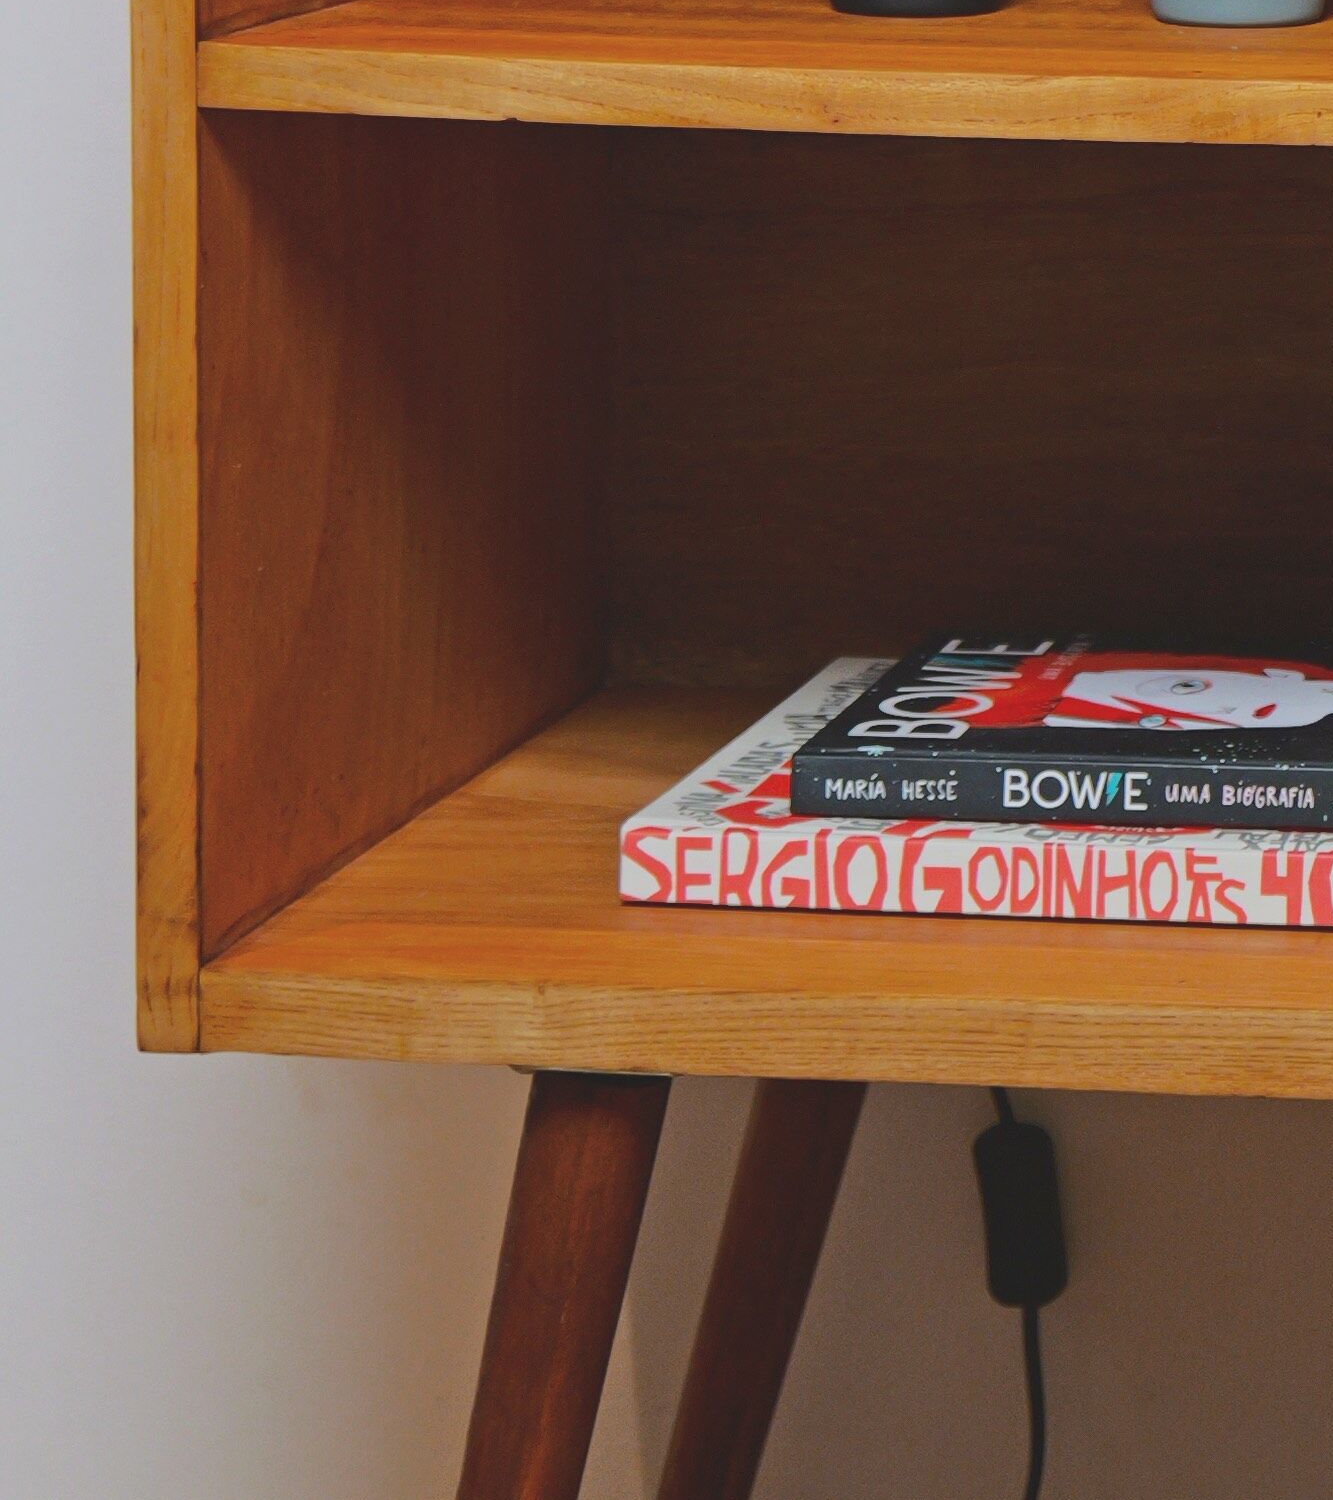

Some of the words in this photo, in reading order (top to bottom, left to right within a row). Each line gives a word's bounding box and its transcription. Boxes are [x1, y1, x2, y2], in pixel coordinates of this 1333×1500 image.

[824, 773, 887, 801] MARÍA
[901, 777, 958, 802] HESSE
[1164, 782, 1211, 804] UMA
[899, 836, 1178, 921] GODINHO
[1186, 875, 1248, 925] AS
